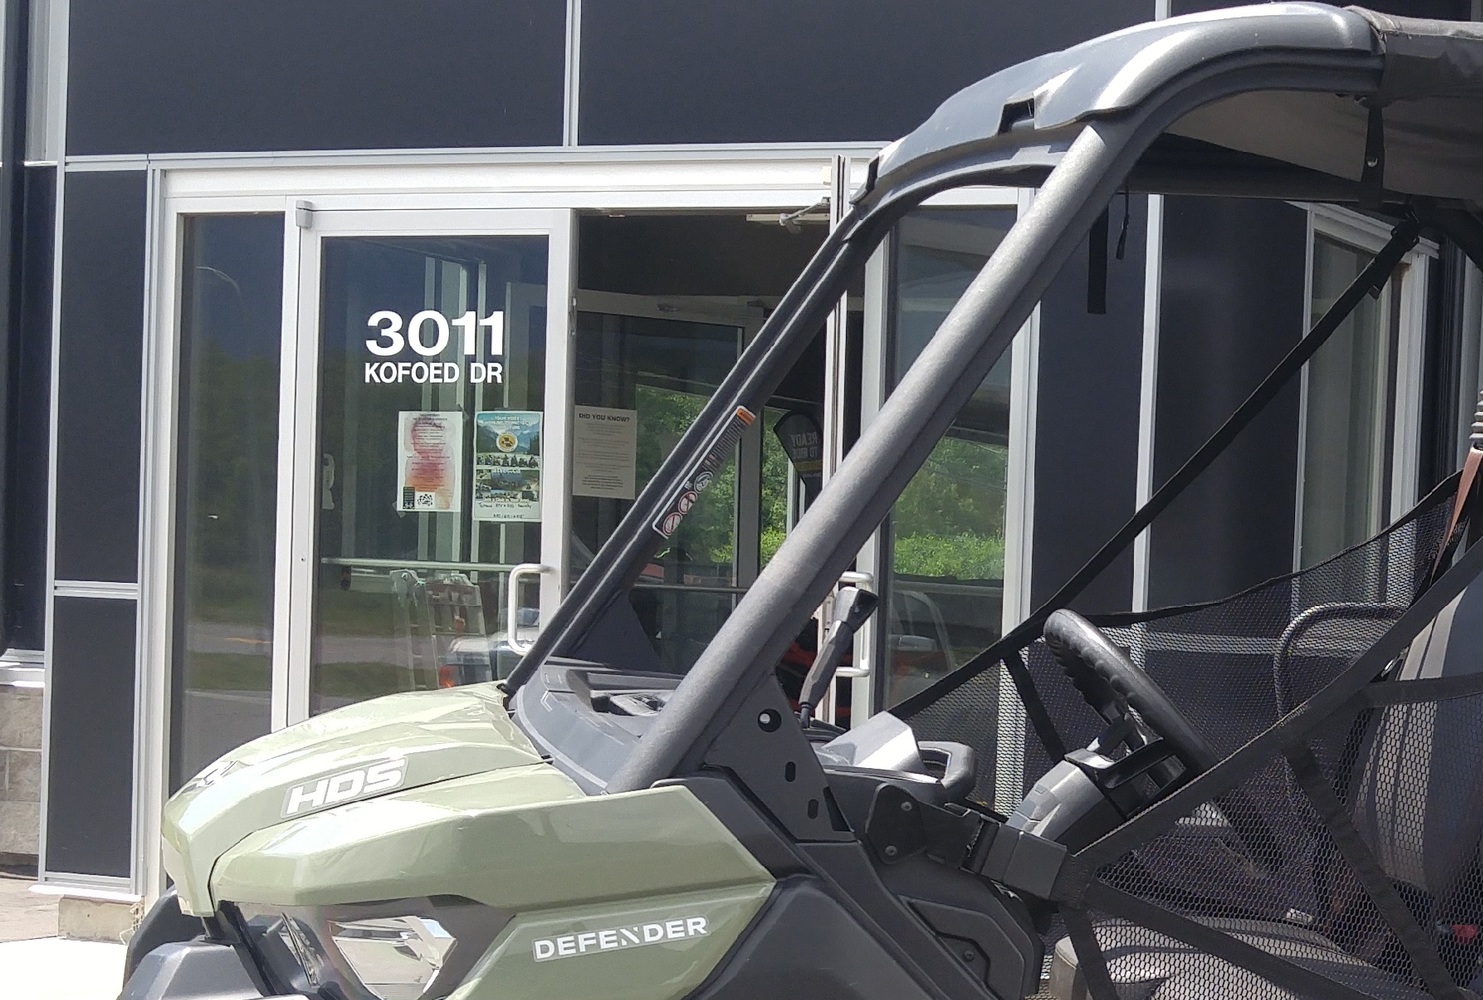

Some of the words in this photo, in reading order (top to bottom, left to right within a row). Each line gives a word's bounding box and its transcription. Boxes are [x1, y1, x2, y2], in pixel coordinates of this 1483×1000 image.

[365, 309, 504, 357] 3011
[364, 361, 460, 384] KOFOED
[470, 362, 503, 384] DR
[592, 413, 606, 421] YOU
[606, 414, 631, 423] KNOW?
[286, 759, 406, 815] HDS
[534, 916, 708, 960] DEFENDER
